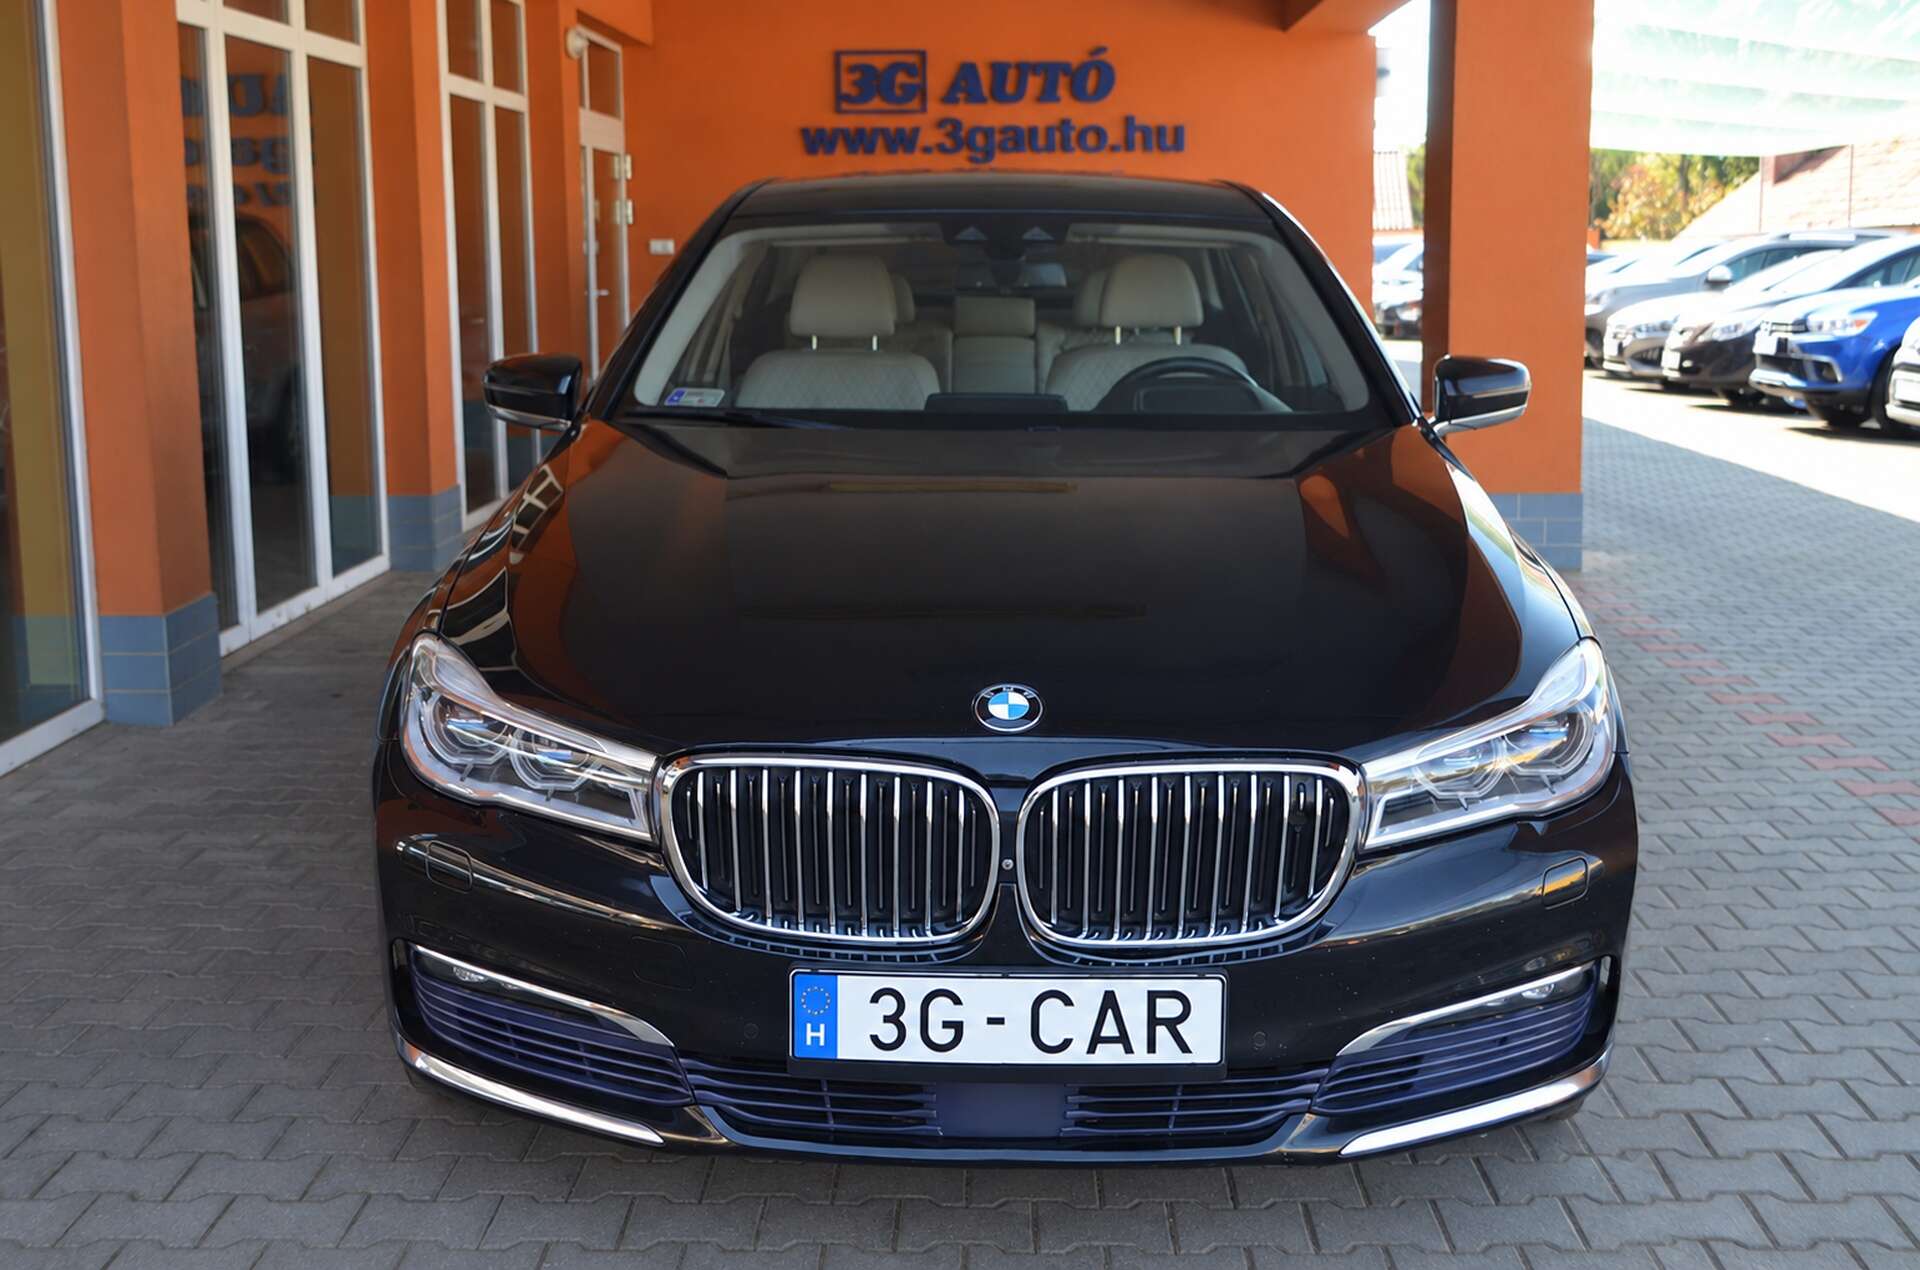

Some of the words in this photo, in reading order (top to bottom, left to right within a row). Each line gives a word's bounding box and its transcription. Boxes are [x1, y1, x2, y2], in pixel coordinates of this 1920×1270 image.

[842, 61, 921, 104] 3G
[940, 46, 1115, 104] AUTÓ
[801, 115, 1186, 164] www.3gauto.hu
[805, 1023, 826, 1046] H
